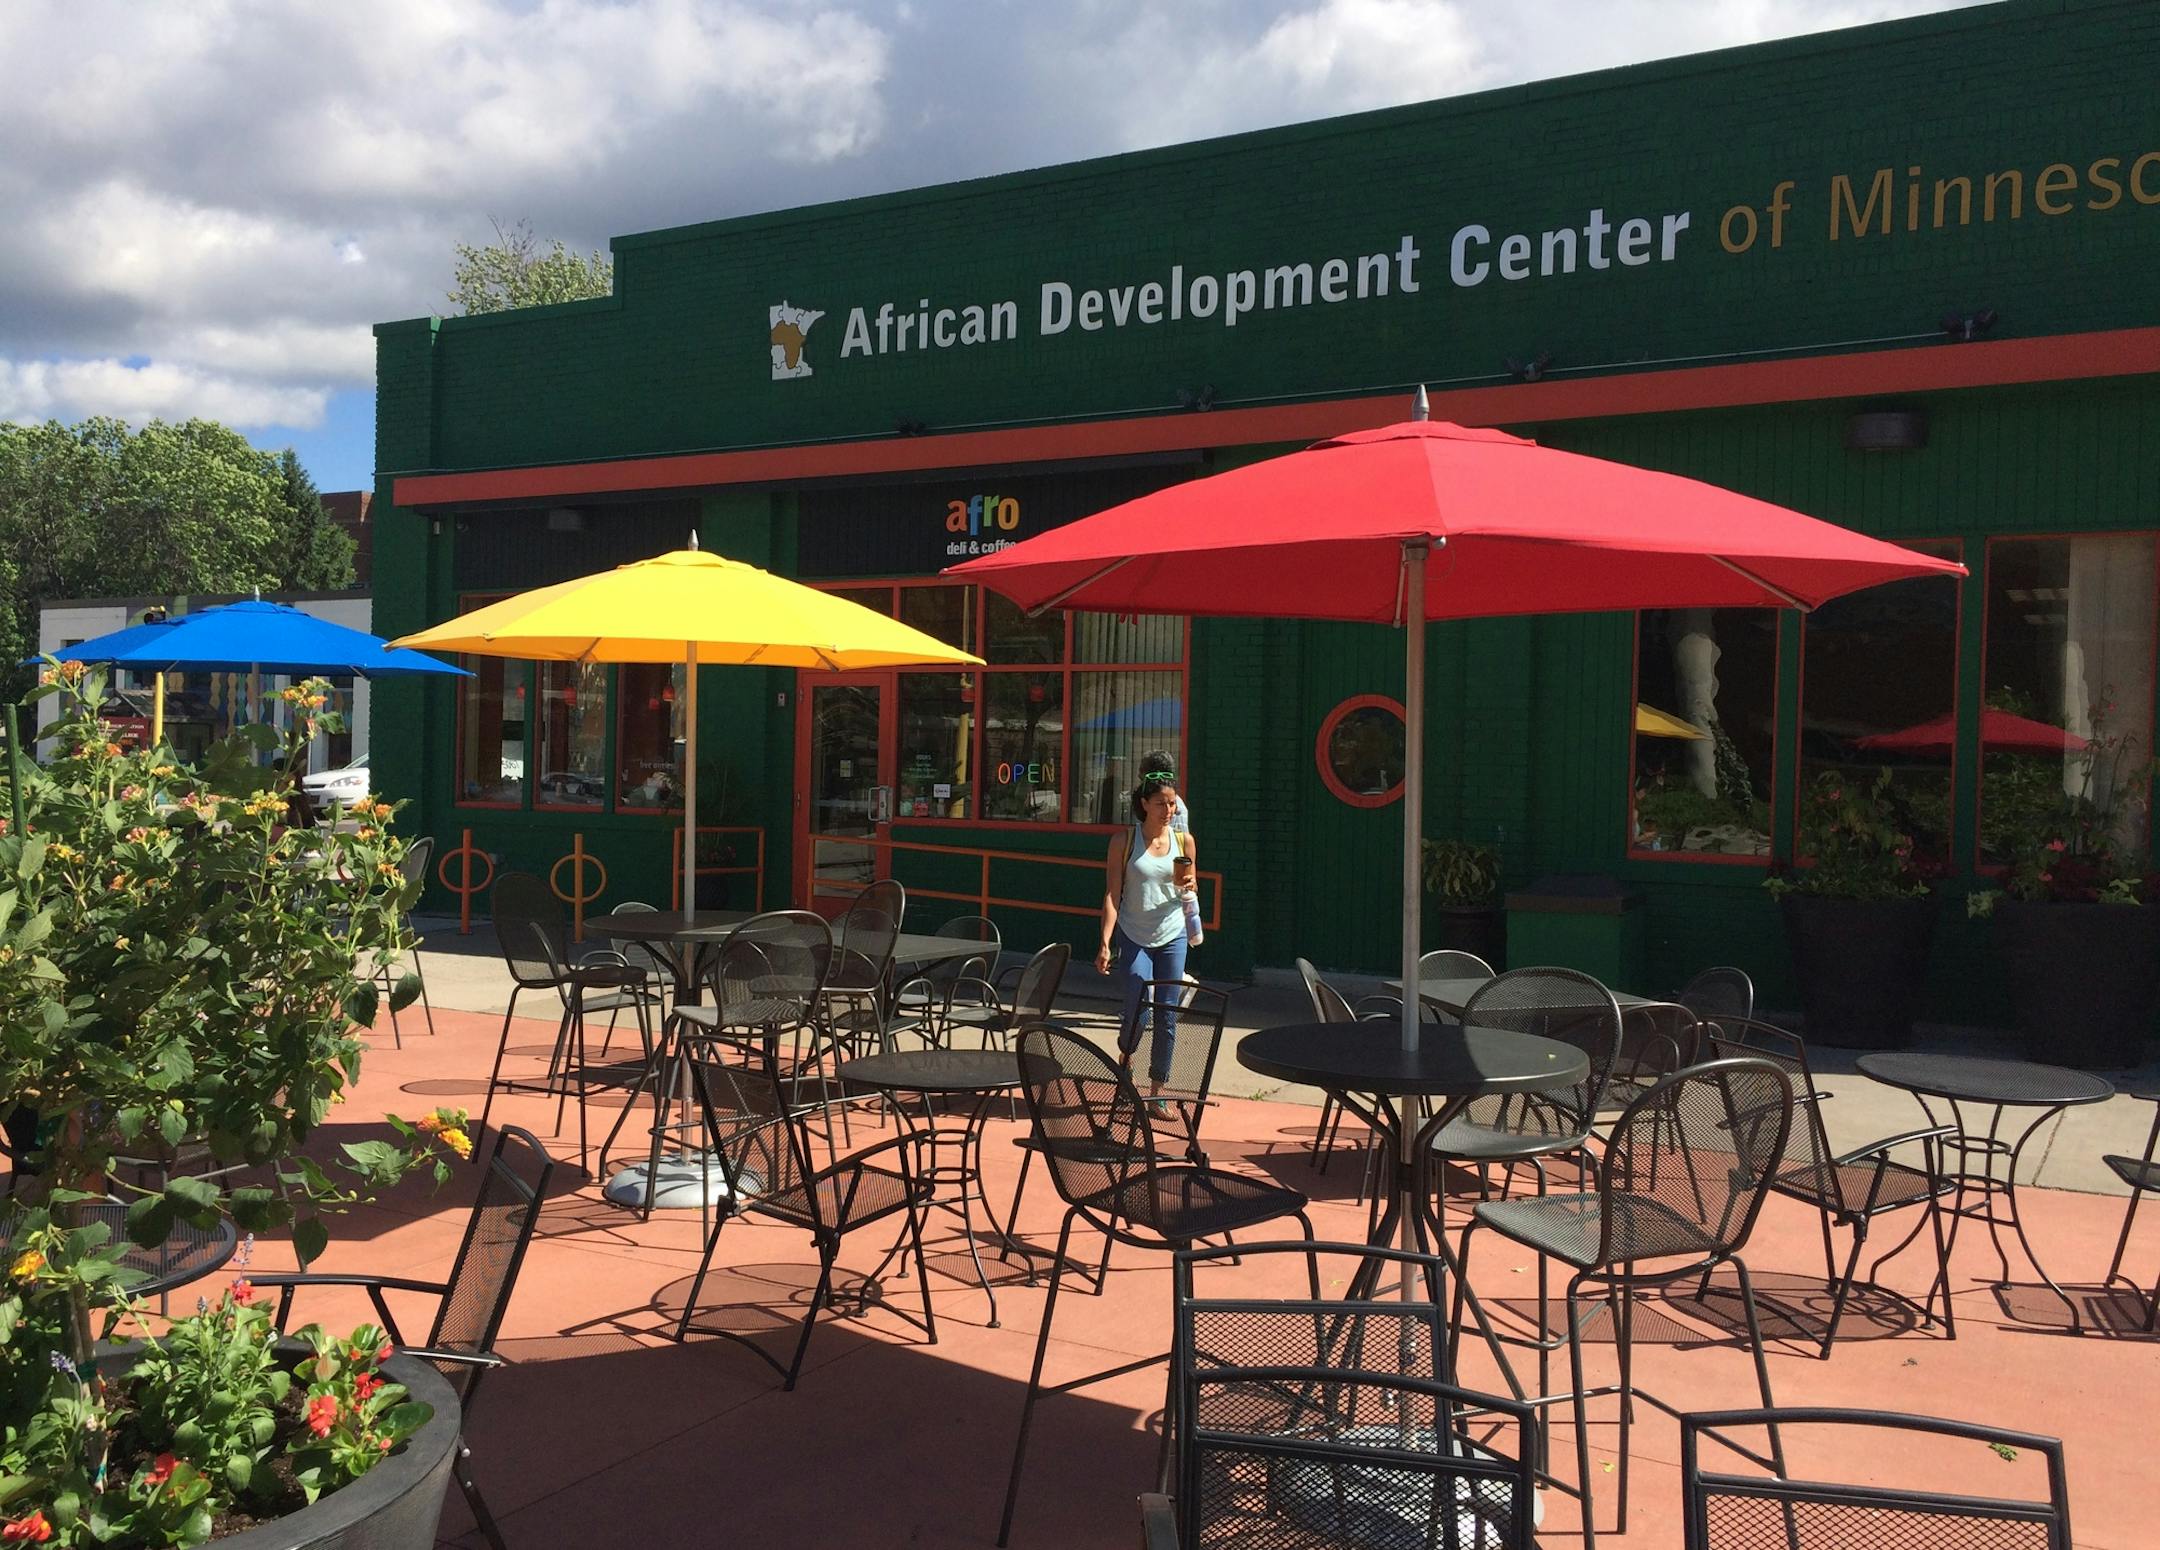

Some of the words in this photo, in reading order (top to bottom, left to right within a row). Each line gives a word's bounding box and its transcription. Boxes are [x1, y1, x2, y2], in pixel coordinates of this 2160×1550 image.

[839, 298, 1018, 359] African
[1039, 234, 1421, 336] Development
[1449, 208, 1691, 288] Center
[1719, 181, 1795, 253] of
[946, 494, 1020, 536] afro
[946, 541, 967, 555] deli
[969, 540, 980, 554] &
[998, 761, 1055, 784] OPEN
